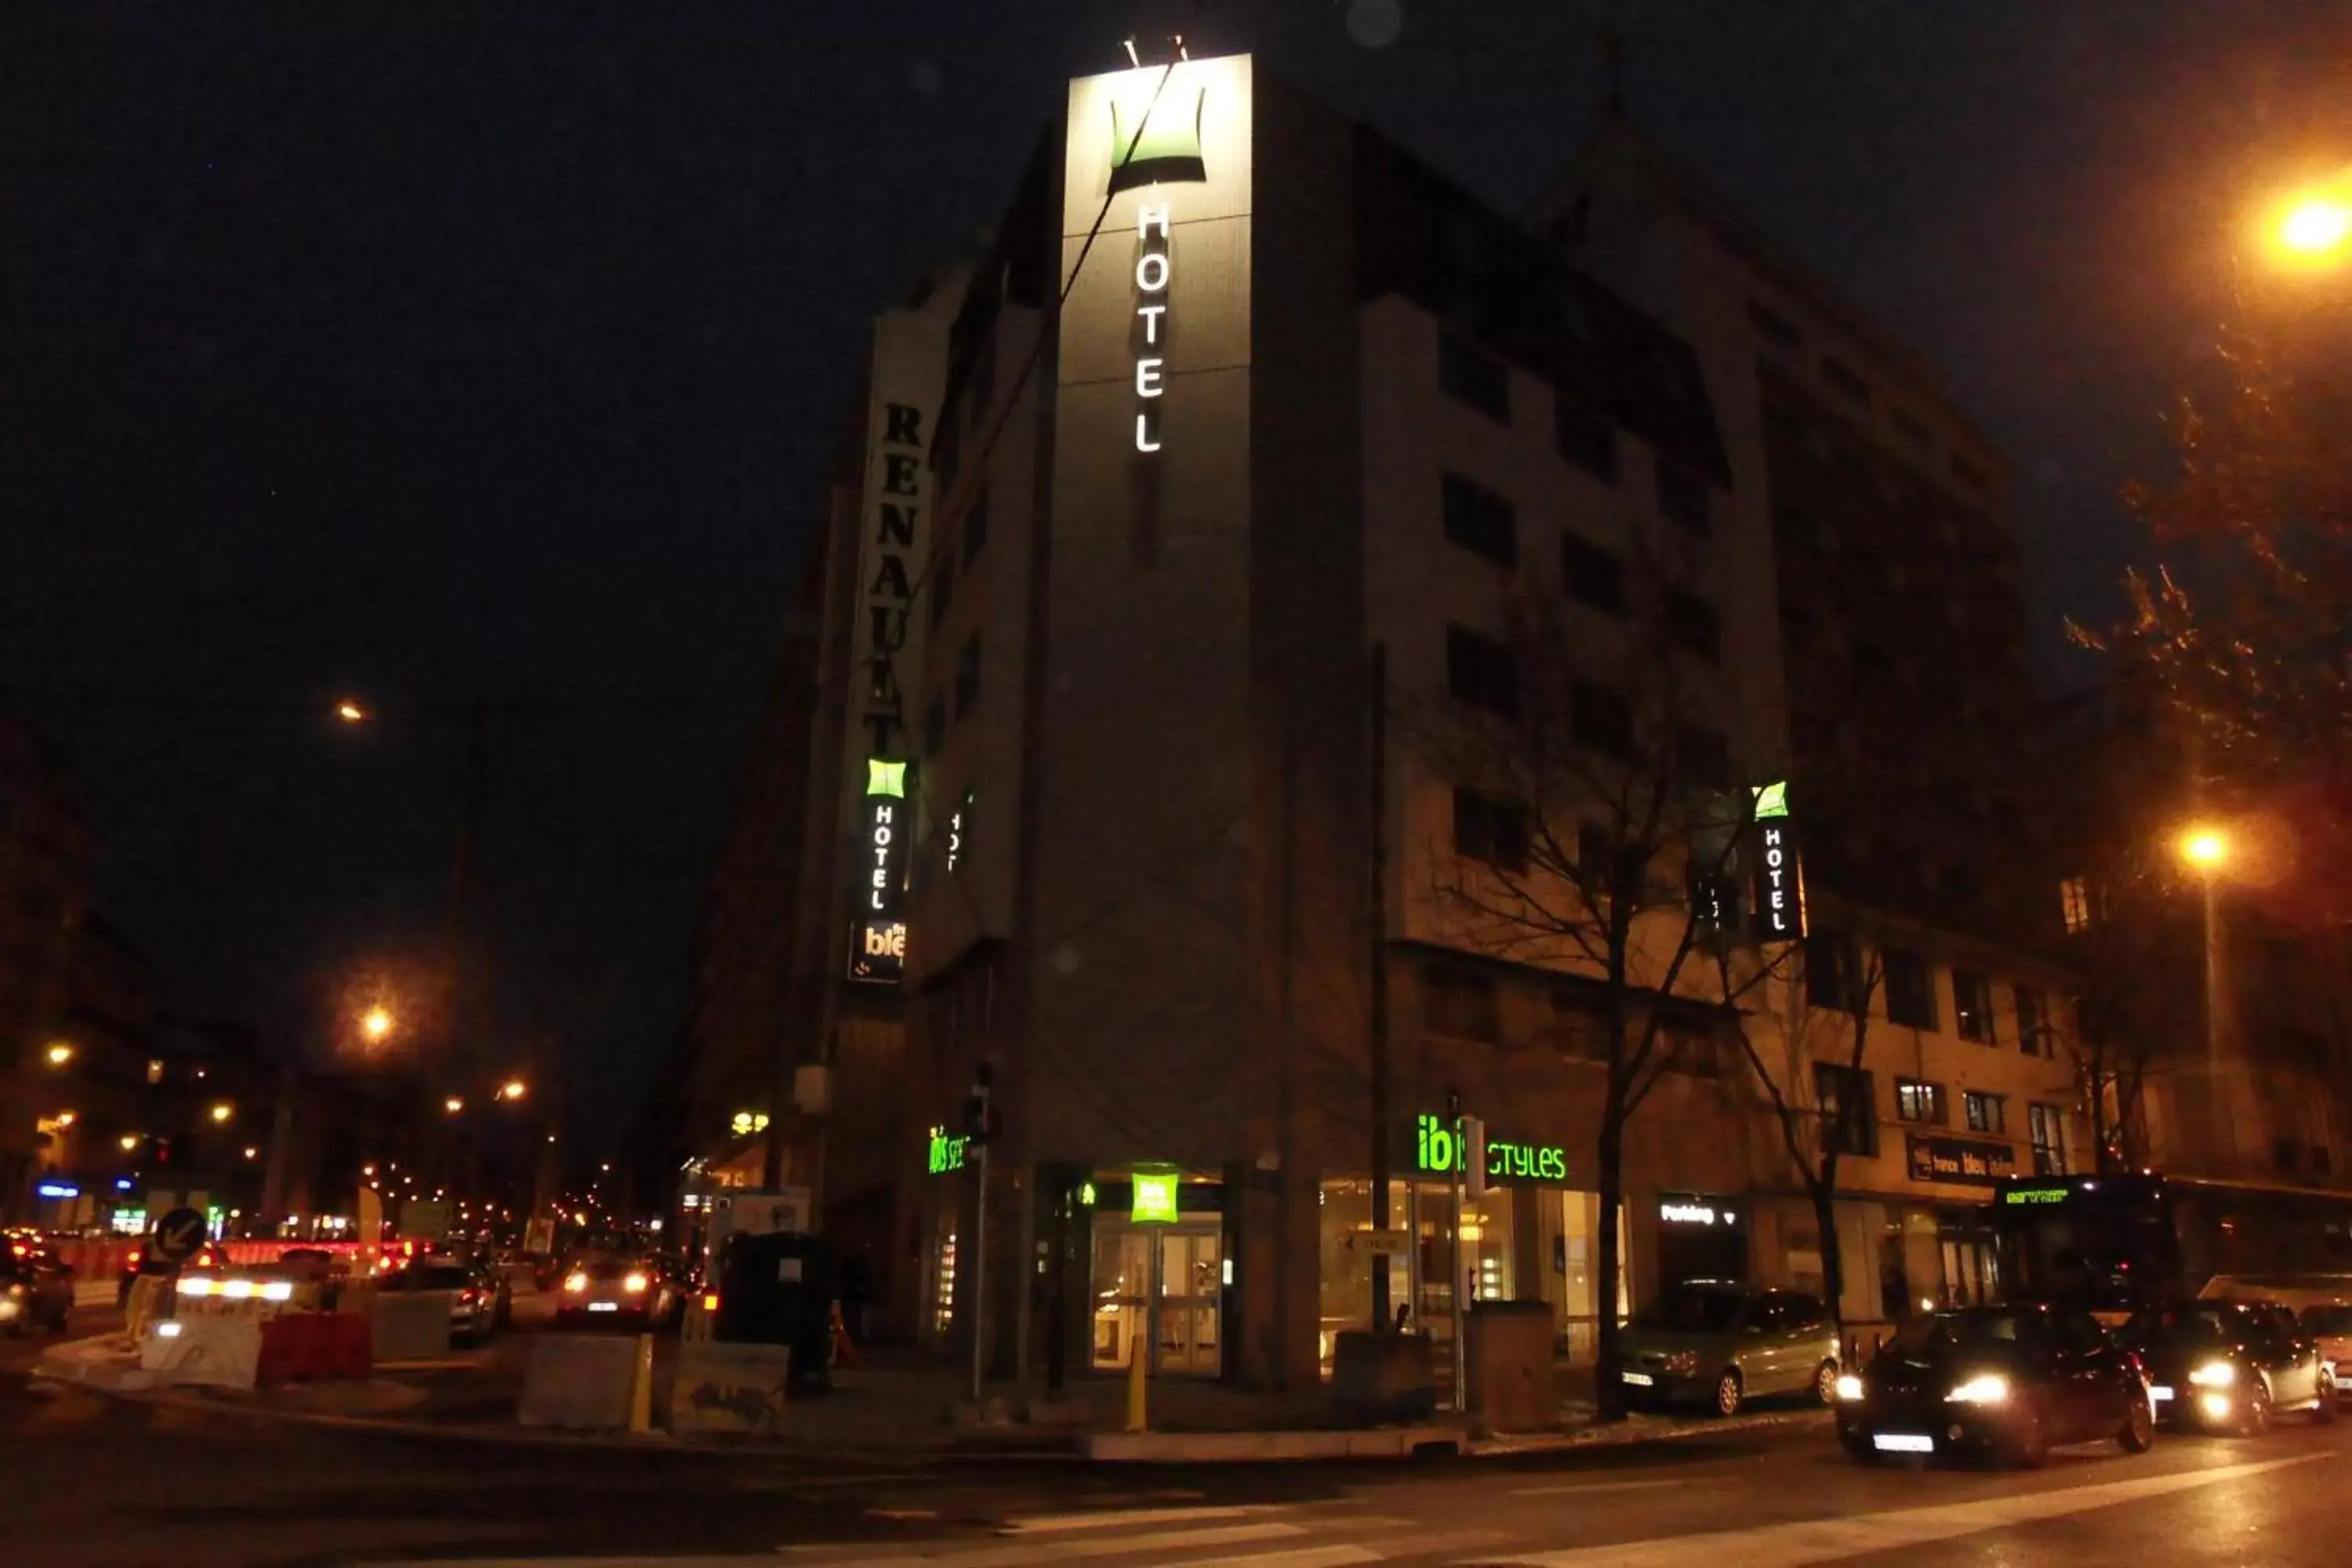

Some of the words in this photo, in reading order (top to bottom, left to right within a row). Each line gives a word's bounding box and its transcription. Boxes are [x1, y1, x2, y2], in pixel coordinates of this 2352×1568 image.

[1136, 201, 1170, 452] HOTEL
[863, 402, 923, 756] RENAULT
[871, 805, 892, 910] HOTEL
[1766, 829, 1785, 931] HOTEL
